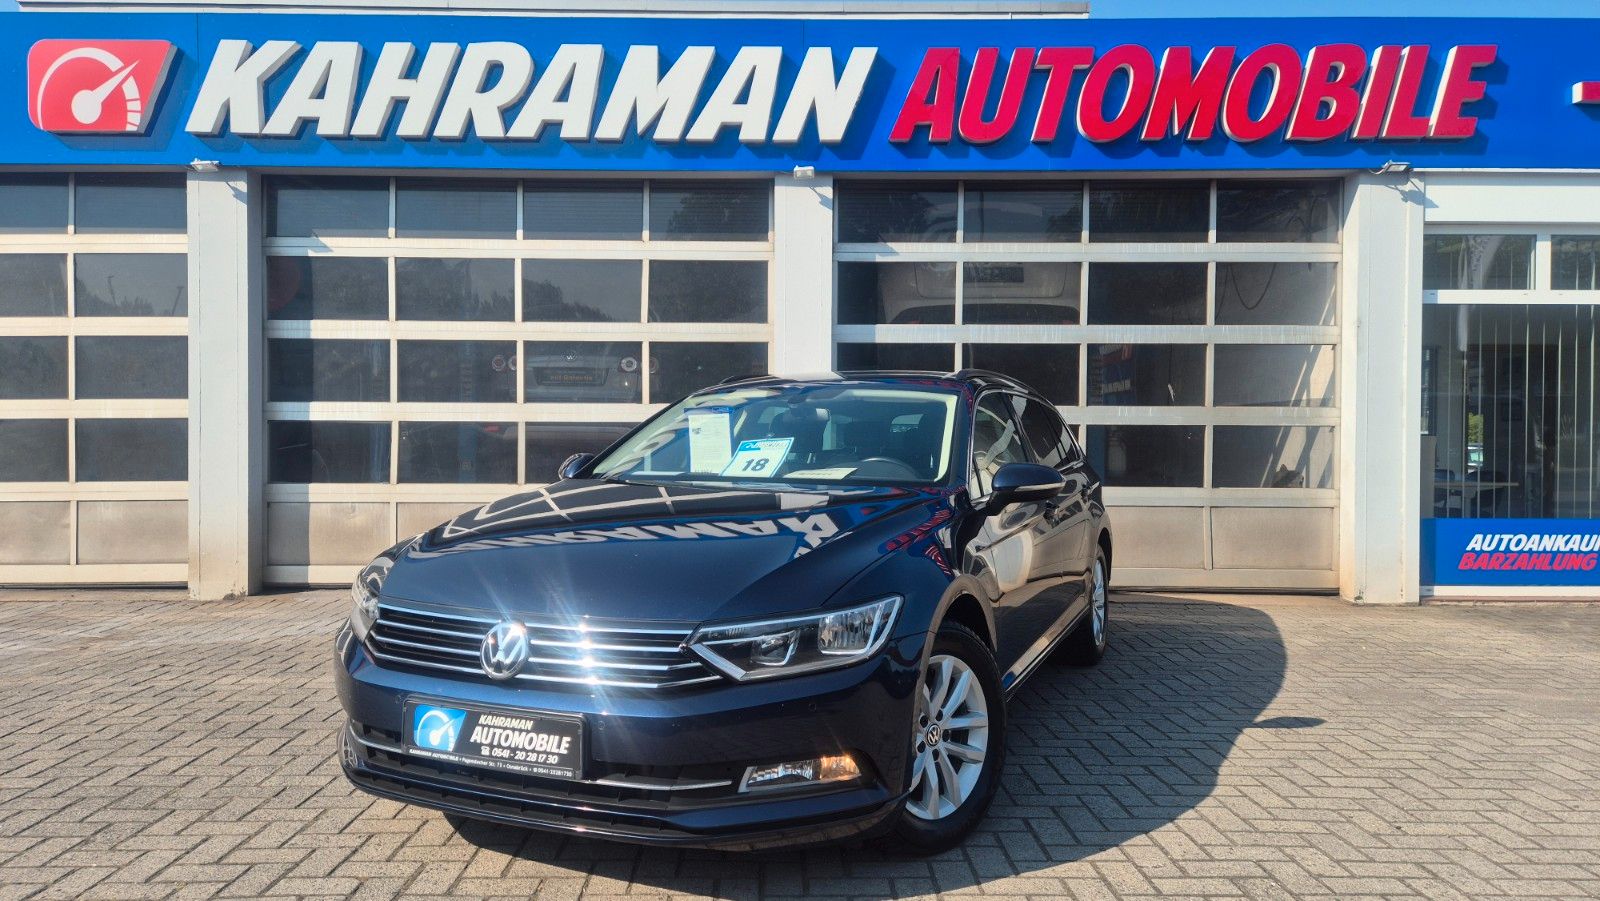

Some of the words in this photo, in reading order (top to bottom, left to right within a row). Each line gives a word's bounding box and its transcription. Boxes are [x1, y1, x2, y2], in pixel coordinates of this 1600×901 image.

[185, 39, 879, 143] KAHRAMAN
[889, 43, 1498, 143] AUTOMOBILE
[742, 458, 770, 472] 18
[1458, 552, 1598, 571] BARZAHLUNG
[478, 714, 533, 731] KAHRAMAN
[469, 726, 572, 755] AUTOMOBILE
[491, 748, 510, 759] 0541
[514, 751, 526, 760] 20
[526, 752, 538, 762] 28
[538, 754, 547, 763] 17
[546, 755, 559, 765] 30
